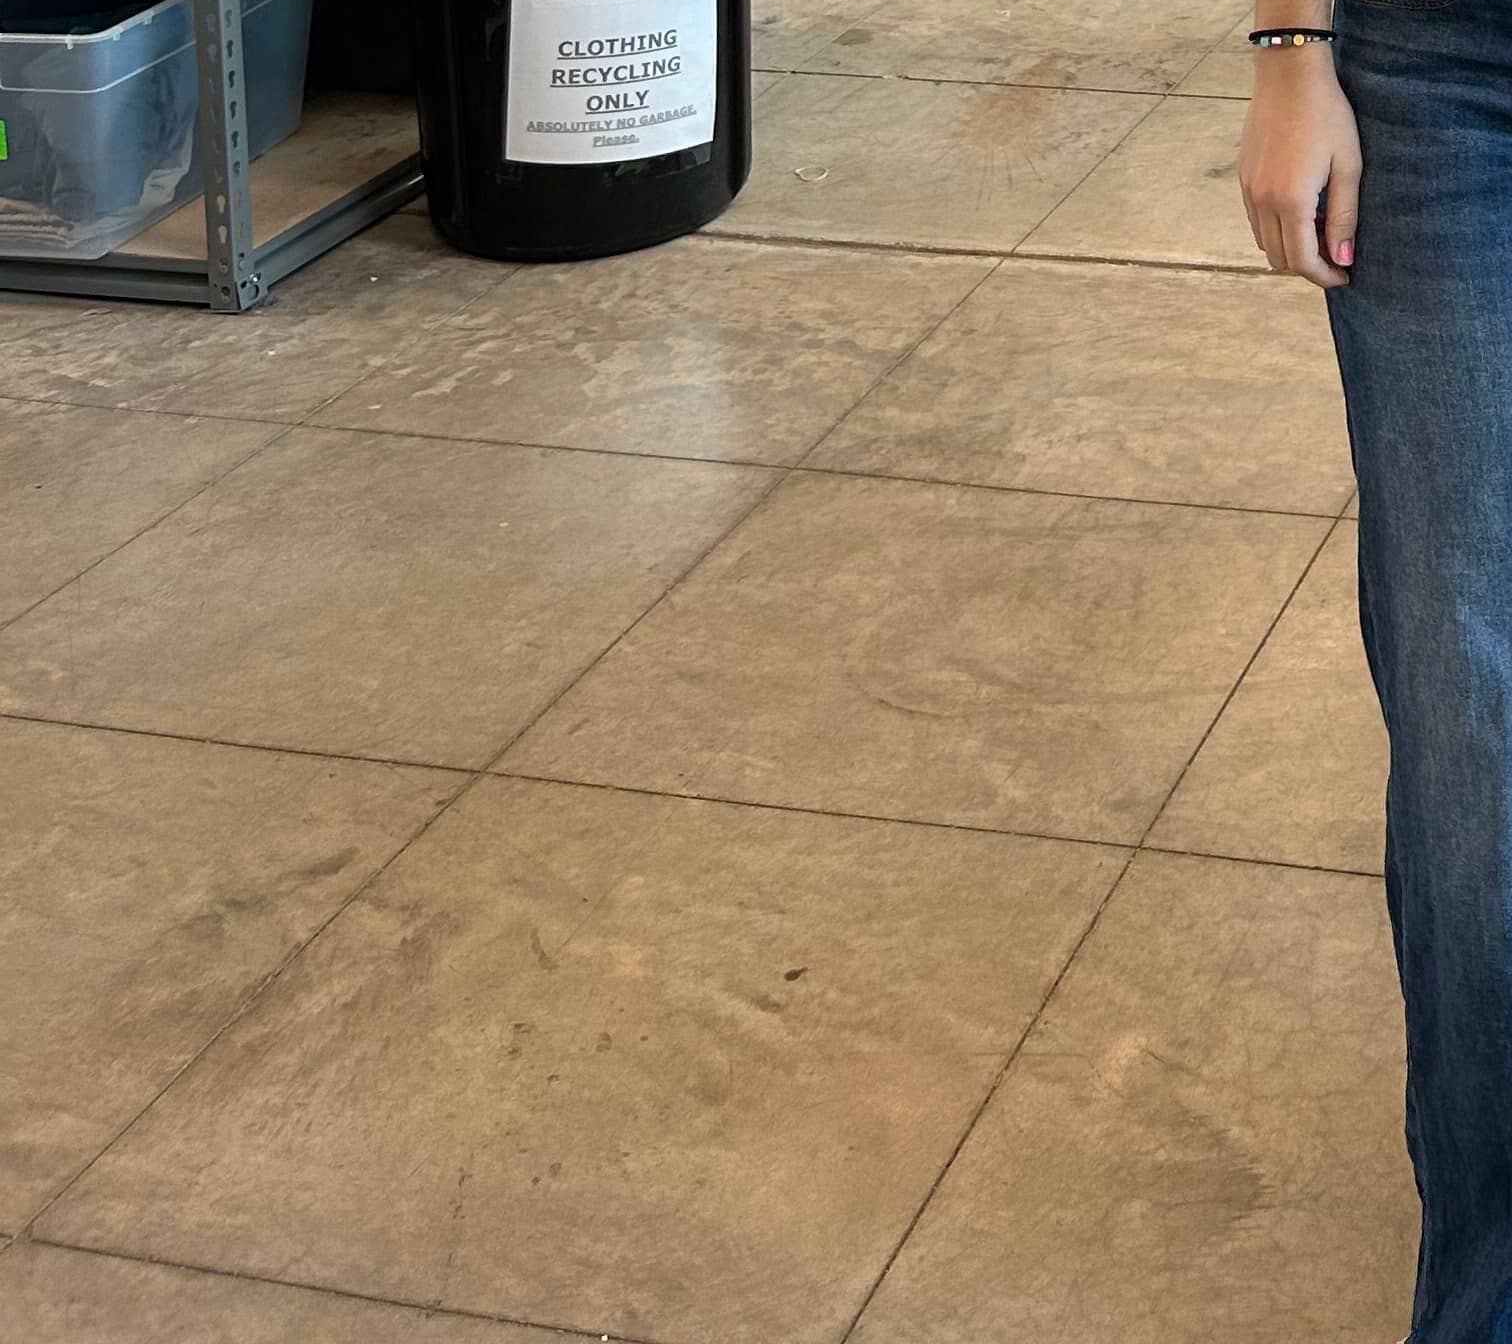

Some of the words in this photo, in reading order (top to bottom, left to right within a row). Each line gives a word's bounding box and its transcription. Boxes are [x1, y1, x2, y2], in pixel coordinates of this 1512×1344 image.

[557, 29, 678, 58] CLOTHING
[551, 56, 681, 86] RECYCLING
[586, 90, 650, 113] ONLY
[526, 119, 613, 132] ABSOLUTELY
[617, 118, 636, 129] NO
[592, 134, 640, 147] Please.
